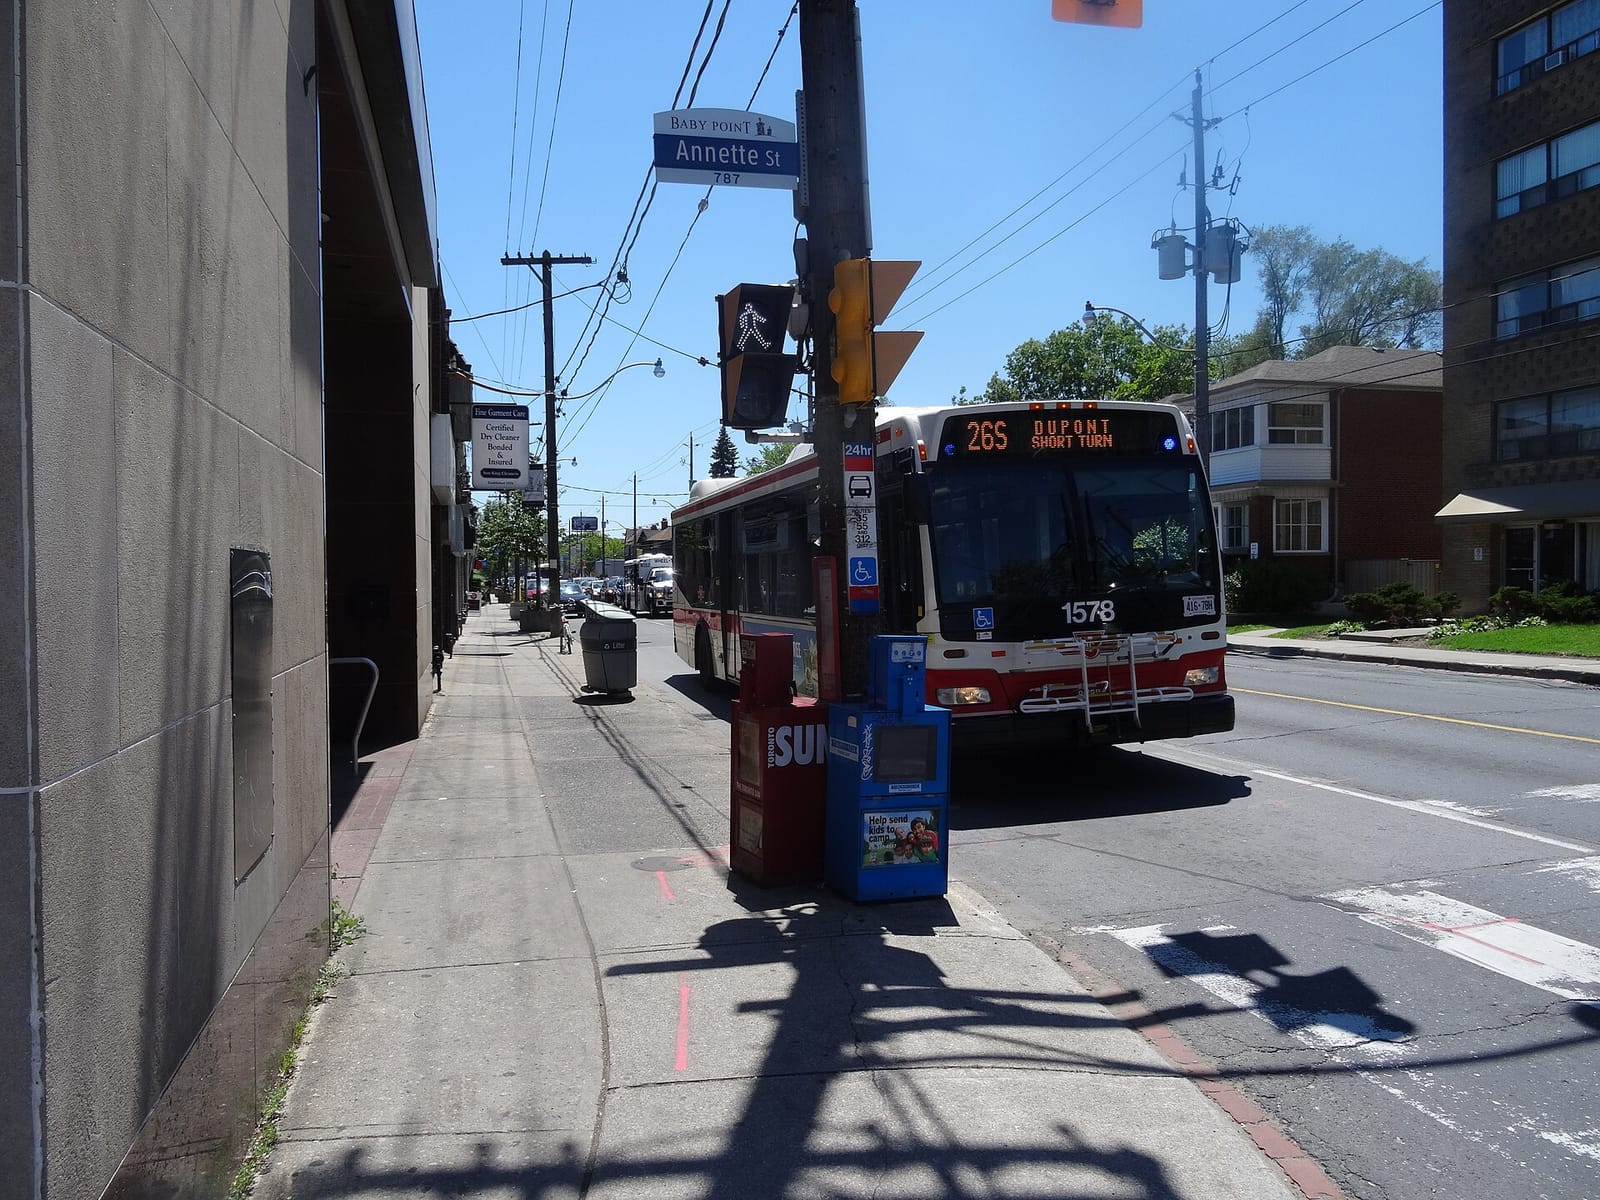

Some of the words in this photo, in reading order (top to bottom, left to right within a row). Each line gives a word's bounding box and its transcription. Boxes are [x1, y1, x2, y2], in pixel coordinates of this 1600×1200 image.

[671, 116, 707, 130] BABY
[712, 121, 751, 134] POINT
[676, 140, 759, 165] Annette
[766, 150, 781, 167] St
[713, 172, 741, 184] 787
[487, 409, 512, 417] Garment
[1034, 419, 1110, 435] DUPONT
[481, 433, 493, 441] Dry
[494, 433, 520, 441] Cleaner
[967, 421, 1008, 450] 26S
[1031, 436, 1073, 448] SHORT
[1078, 434, 1113, 448] TURN
[488, 443, 513, 451] Bonded
[845, 444, 872, 456] 24hr
[855, 514, 868, 522] 35
[856, 522, 868, 530] 55
[855, 535, 871, 543] 312
[1061, 600, 1116, 624] 1578
[767, 727, 775, 769] TORONTO
[869, 815, 887, 825] Help
[889, 814, 908, 824] send
[869, 826, 885, 835] kids
[869, 835, 890, 844] camp
